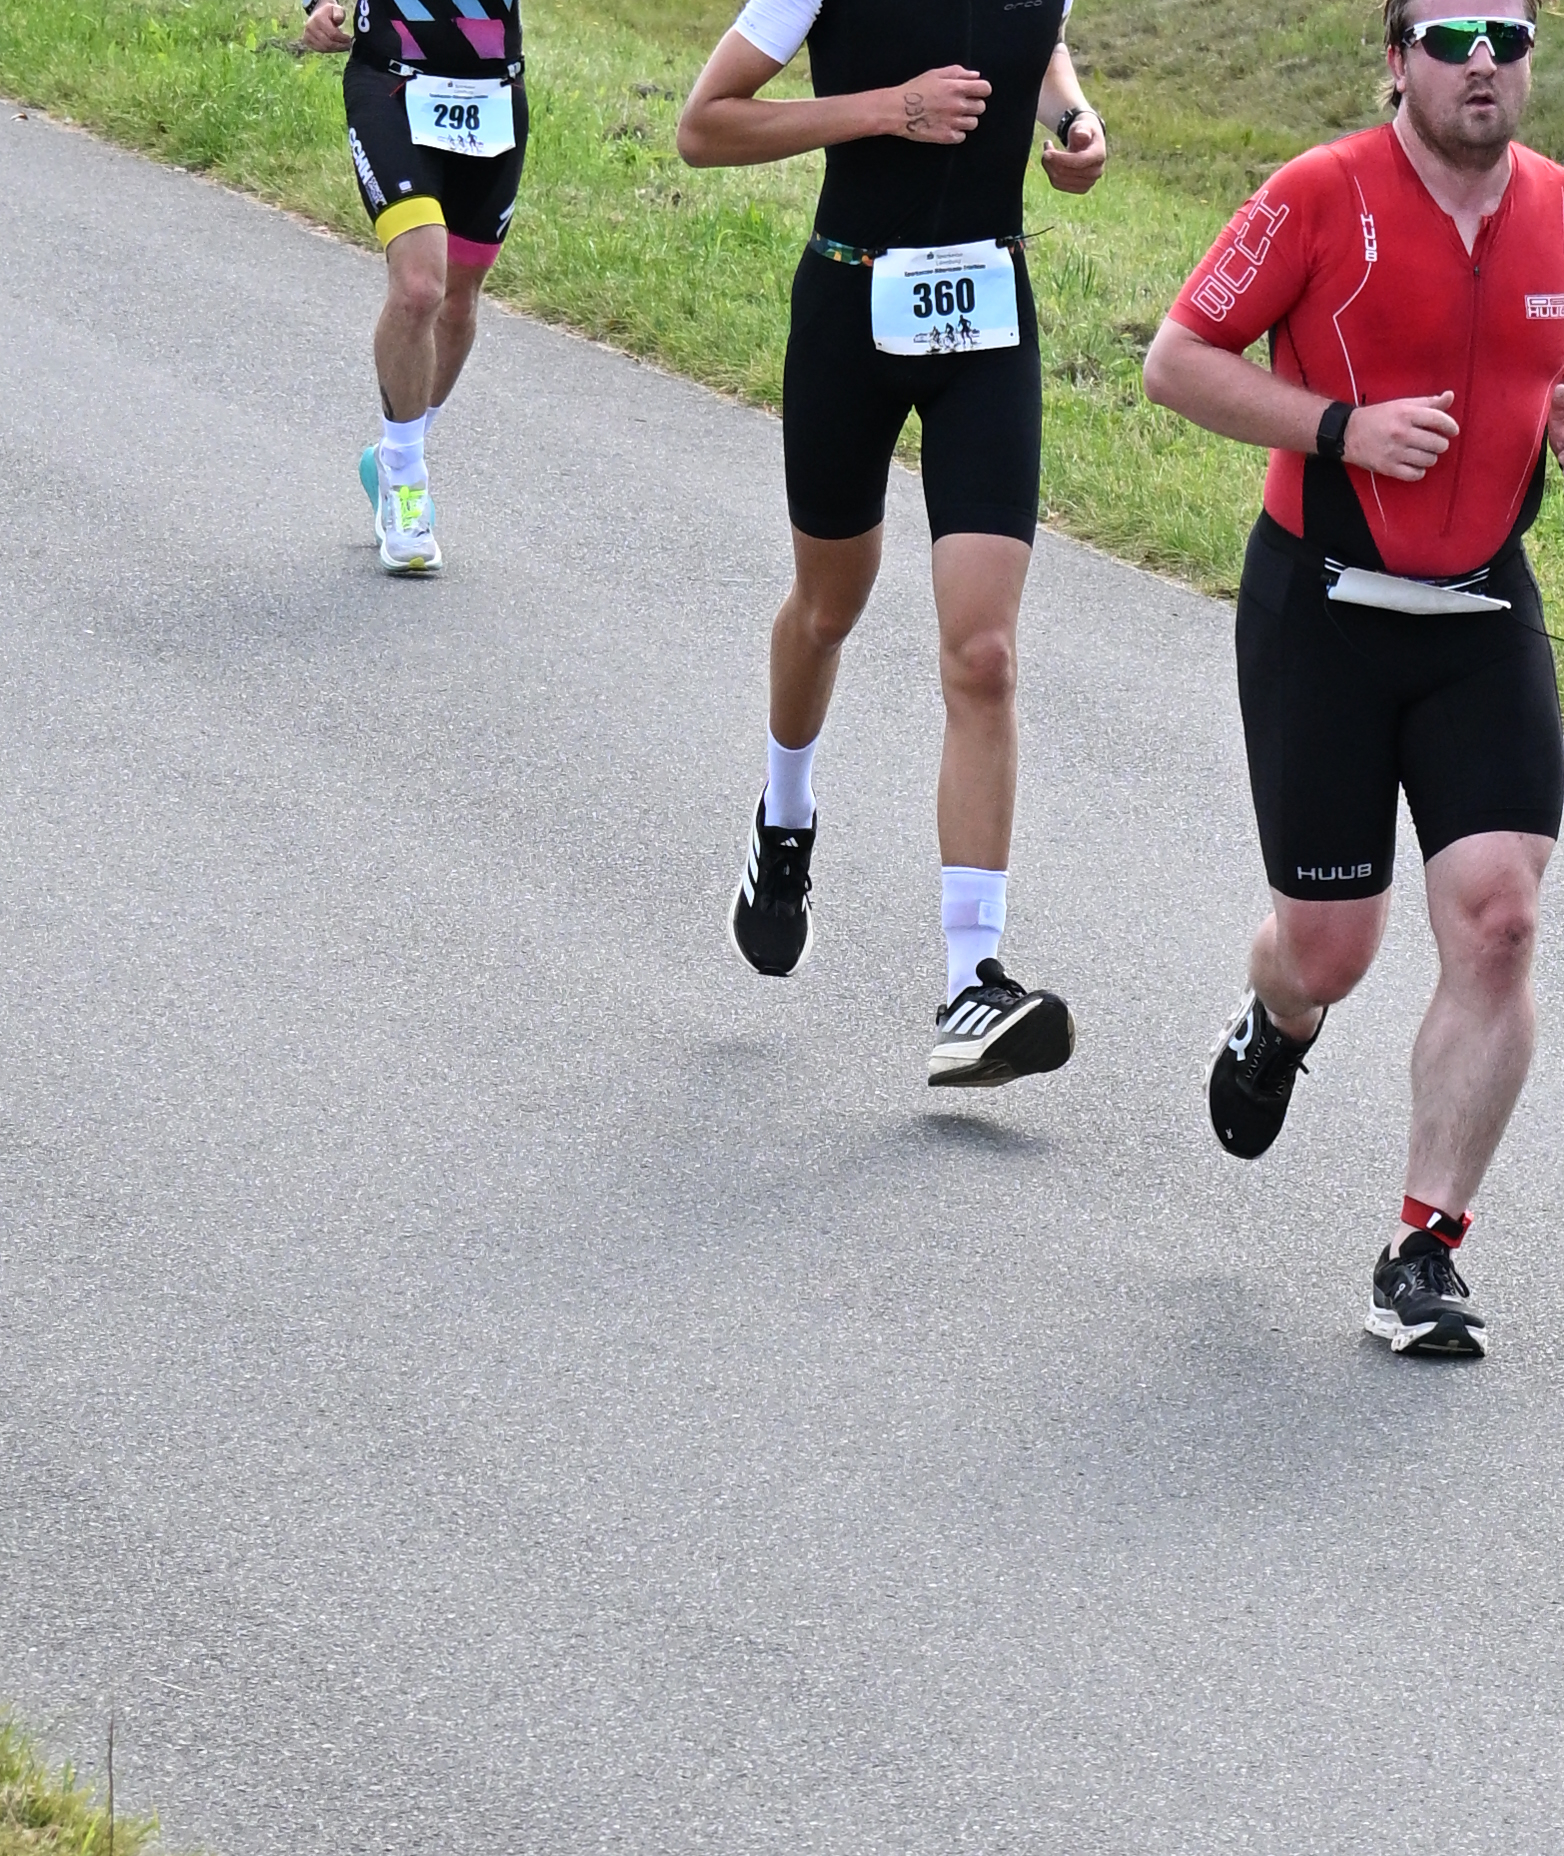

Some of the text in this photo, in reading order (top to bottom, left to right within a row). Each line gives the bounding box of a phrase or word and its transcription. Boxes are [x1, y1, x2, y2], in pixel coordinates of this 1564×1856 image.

[433, 103, 480, 131] 298
[904, 92, 931, 132] 360
[1360, 213, 1378, 263] HUUB
[912, 277, 976, 319] 360
[1296, 862, 1373, 882] HUUB
